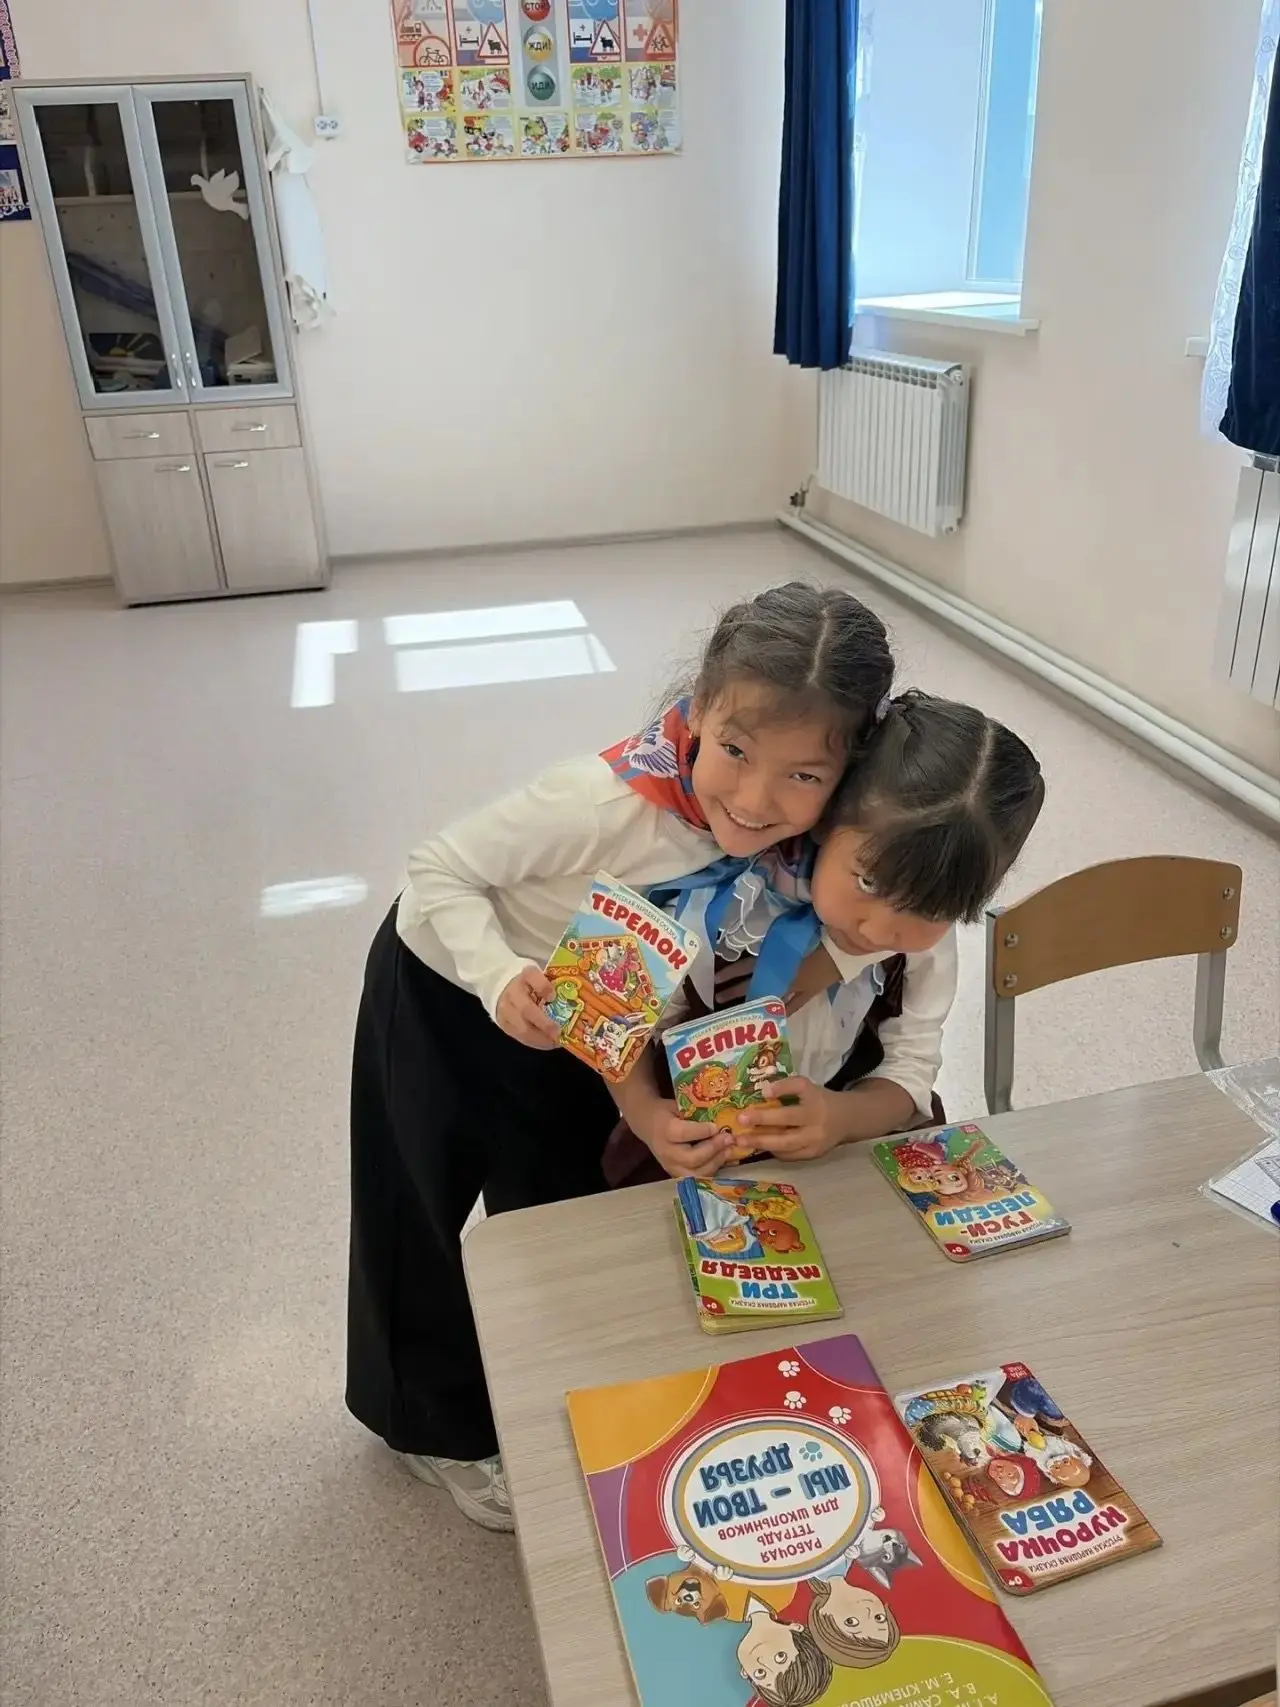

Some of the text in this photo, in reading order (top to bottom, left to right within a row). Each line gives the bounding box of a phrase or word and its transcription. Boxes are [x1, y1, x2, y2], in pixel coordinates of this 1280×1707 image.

[528, 38, 552, 51] ЖДИ!
[591, 892, 688, 970] ТЕРЕМОК
[675, 1020, 779, 1069] РЕПКА
[934, 1191, 1037, 1226] ЛЕБЕДИ
[960, 1211, 1034, 1238] ГУСИ-
[701, 1260, 821, 1281] МЕДВЕДЯ
[741, 1281, 798, 1299] ТРИ
[699, 1442, 794, 1491] ДРУЗЬЯ
[798, 1463, 852, 1499] МЫ
[692, 1487, 768, 1528] ТВОИ
[718, 1497, 840, 1540] ДЛЯ ШКОЛЬНИКОВ
[1000, 1490, 1095, 1535] РЯБА
[757, 1523, 815, 1546] ТЕТРАДЬ
[760, 1537, 823, 1563] РАБОЧАЯ
[997, 1506, 1128, 1562] КУРОЧКА
[1028, 1534, 1124, 1573] РУССКАЯ НАРОДНАЯ СКАЗКА
